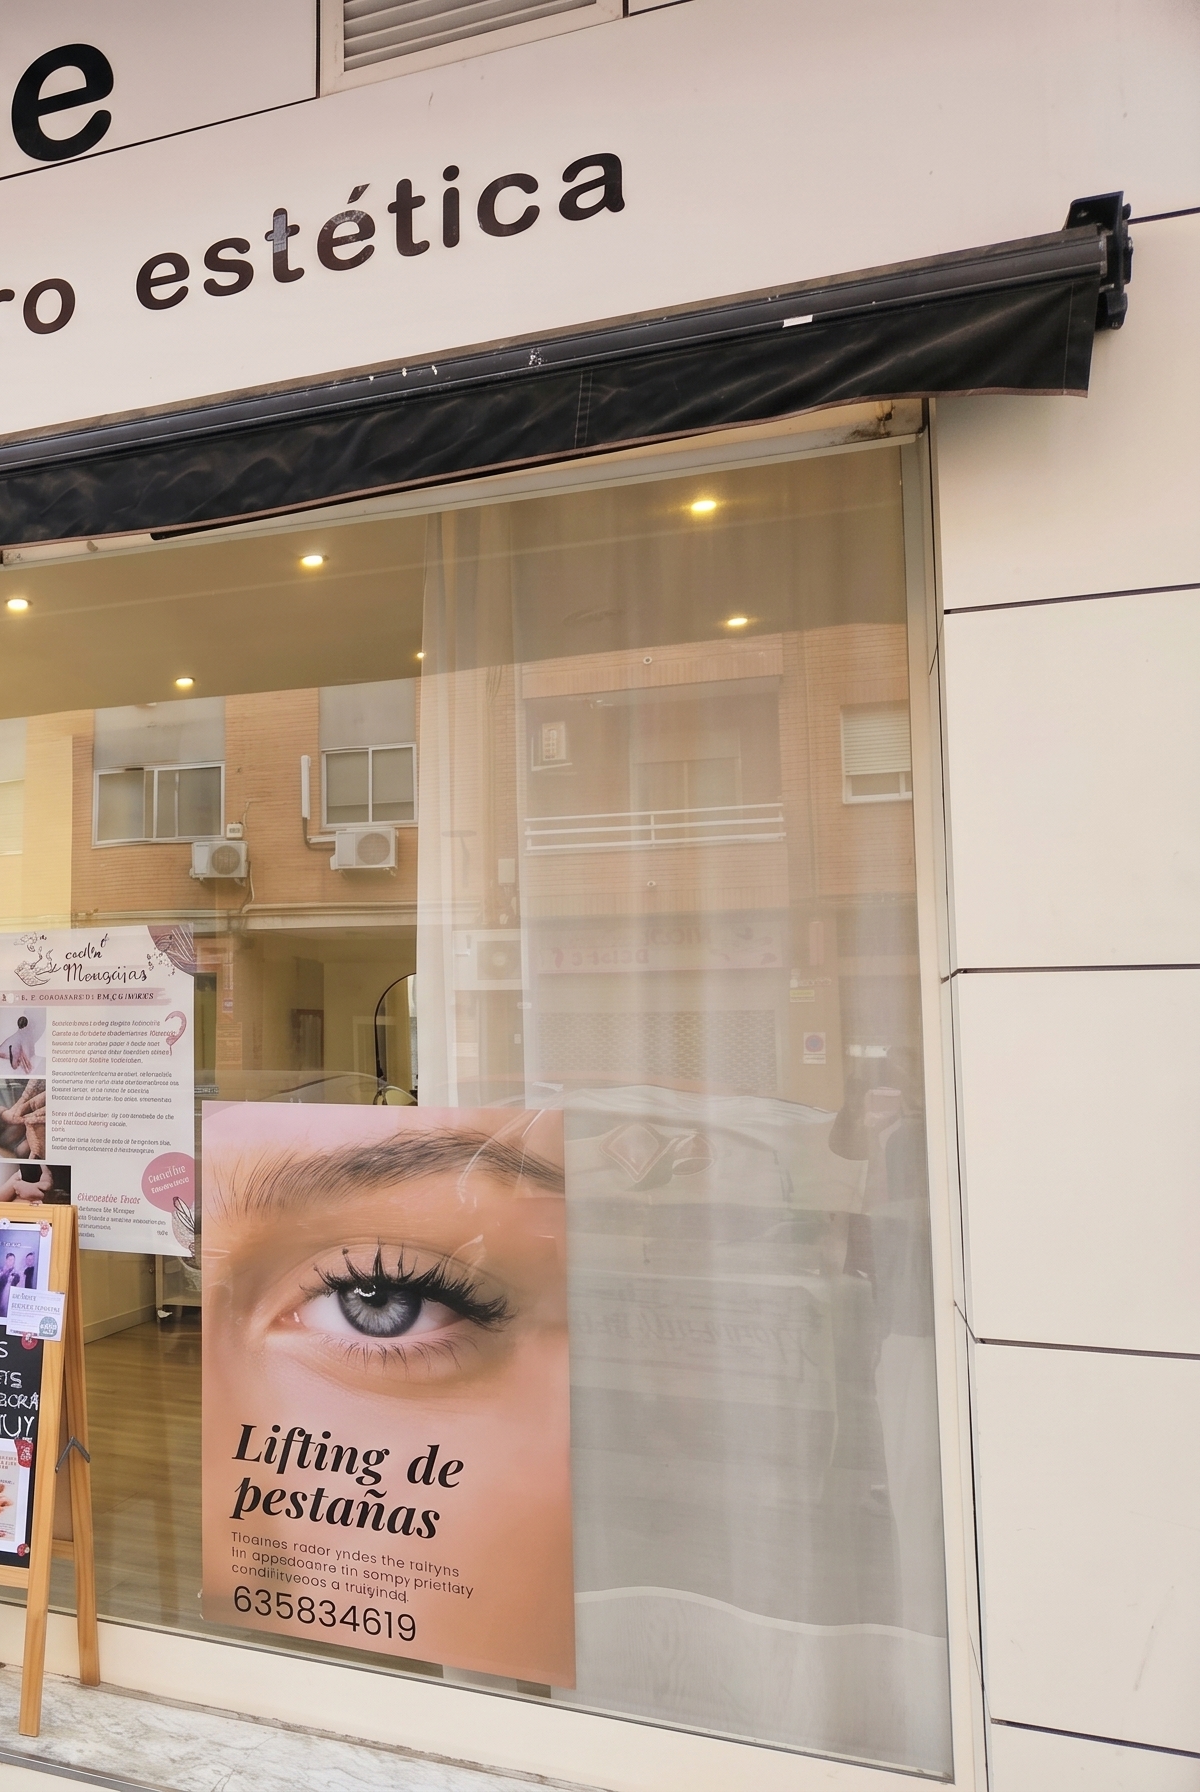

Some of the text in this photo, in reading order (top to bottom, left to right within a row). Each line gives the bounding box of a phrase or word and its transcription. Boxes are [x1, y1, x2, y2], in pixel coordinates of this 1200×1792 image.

[136, 153, 626, 310] estética
[232, 1423, 465, 1488] Lifting de
[229, 1477, 441, 1539] pestañas
[381, 1554, 405, 1569] the
[233, 1585, 416, 1642] 635834619
